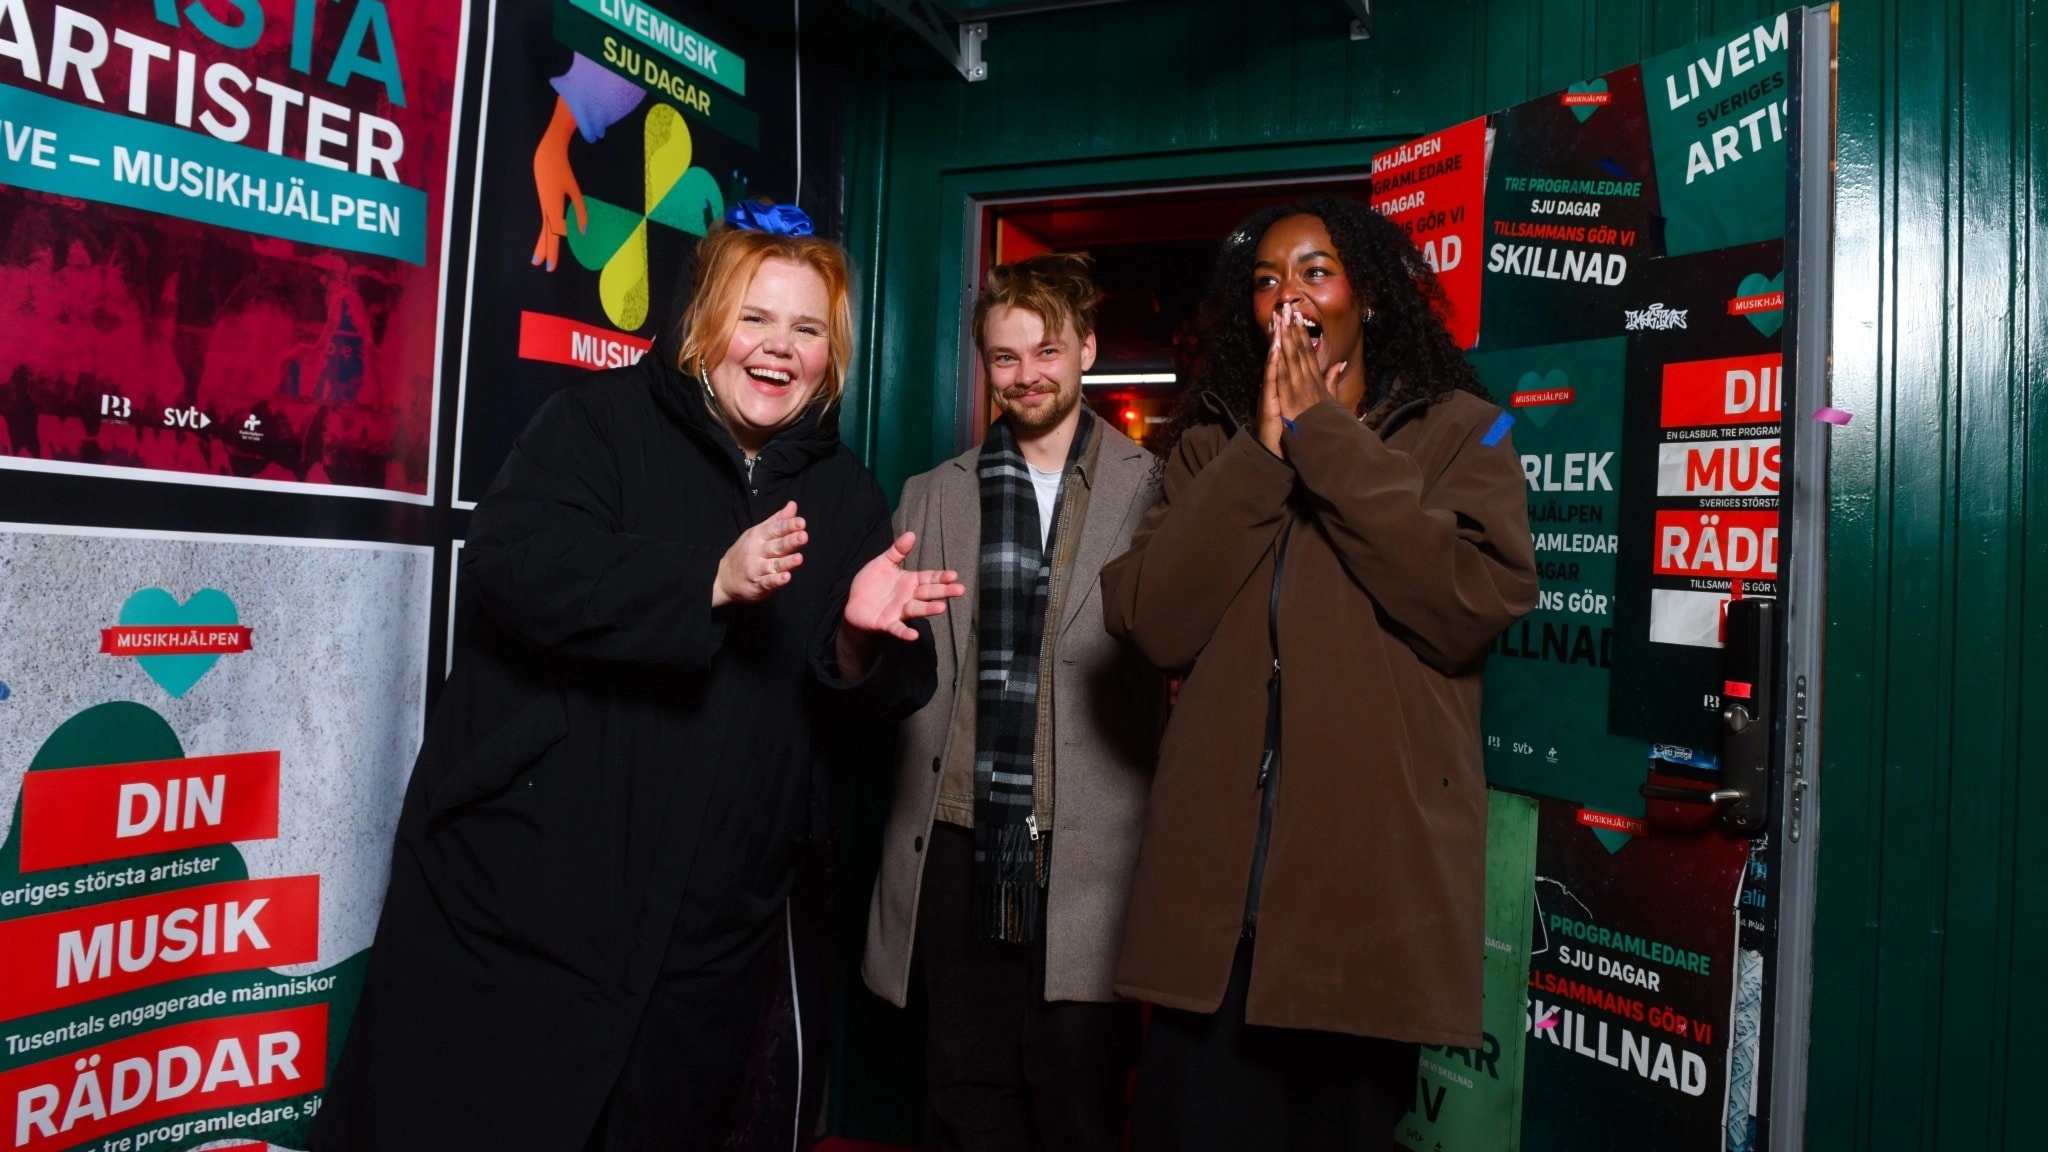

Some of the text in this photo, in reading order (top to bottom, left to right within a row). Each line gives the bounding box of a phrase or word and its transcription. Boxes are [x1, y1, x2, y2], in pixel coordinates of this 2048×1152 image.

[1666, 12, 1788, 110] LIVEM
[603, 36, 711, 117] SJU DAGAR
[0, 0, 405, 183] ARTISTER
[1697, 72, 1784, 128] SVERIGES
[0, 119, 57, 169] VE
[113, 145, 400, 237] MUSIKHJÄLPEN
[1505, 178, 1642, 197] TRE PROGRAMLEDARE
[1382, 190, 1425, 216] DAGAR
[1531, 199, 1600, 217] SJU DAGAR
[1417, 209, 1446, 233] GÖR
[1450, 205, 1465, 224] VI
[1494, 220, 1636, 247] TILLSAMMANS GÖR VI
[1415, 234, 1461, 274] AD
[1487, 243, 1627, 286] SKILLNAD
[571, 330, 649, 369] MUSIK
[100, 394, 131, 418] P3
[1515, 391, 1569, 404] MUSIKHJÄLPEN
[163, 406, 199, 429] svt
[1666, 426, 1781, 440] EN GLASBUR, TRE PROGRAM
[1699, 498, 1740, 508] SVERIGES
[1752, 581, 1771, 592] GÖR
[1534, 588, 1607, 614] NS GÖR
[117, 631, 239, 648] MUSIKHJÄLPEN
[1704, 694, 1720, 708] P3
[1512, 742, 1528, 755] svt
[116, 774, 226, 838] DIN
[1583, 813, 1642, 831] MUSIKHJÄLPEN
[0, 856, 220, 906] eriges största artister
[56, 898, 271, 988] MUSIK
[1485, 936, 1512, 953] DAGAR
[1550, 913, 1711, 976] PROGRAMLEDARE
[1559, 945, 1660, 992] SJU DAGAR
[6, 974, 336, 1055] Tusentals engagerade människor
[1649, 1005, 1688, 1037] GÖR
[1693, 1019, 1712, 1046] VI
[15, 1031, 301, 1147] RÄDDAR
[1438, 1066, 1473, 1088] SKILLNAD
[103, 1137, 131, 1152] tre
[136, 1105, 299, 1151] programledare,
